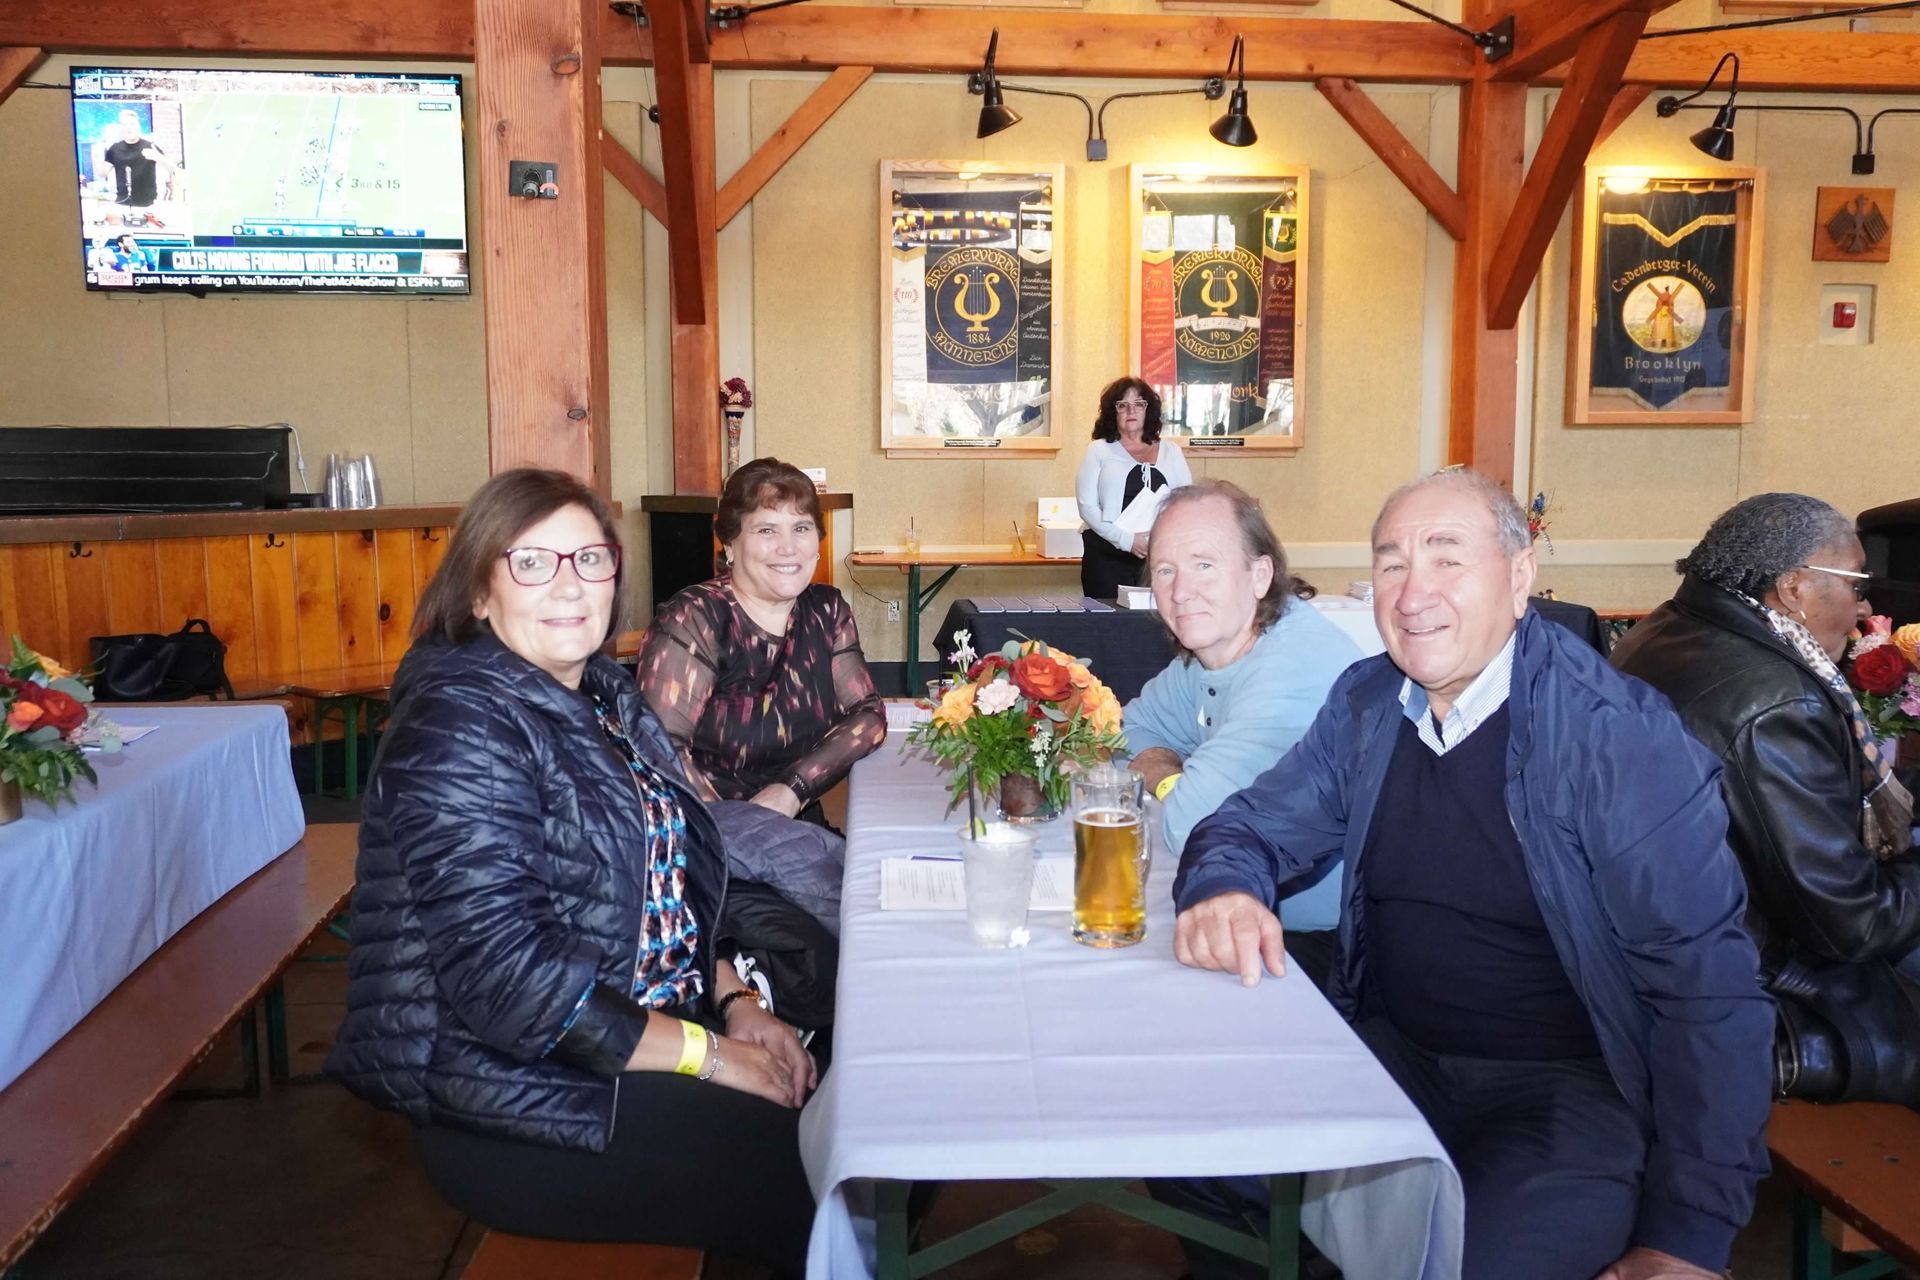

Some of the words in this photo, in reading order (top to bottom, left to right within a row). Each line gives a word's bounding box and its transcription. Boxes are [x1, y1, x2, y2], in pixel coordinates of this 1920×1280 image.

[387, 179, 400, 189] 15
[172, 251, 207, 270] COLTS
[208, 252, 250, 271] MOVING
[251, 252, 304, 272] FORWARD
[304, 253, 334, 272] WITH
[334, 253, 356, 272] JOE
[356, 253, 399, 273] FLACCO
[162, 273, 190, 287] keeps
[192, 274, 222, 287] rolling
[224, 277, 236, 286] on
[397, 277, 407, 287] &
[408, 277, 440, 288] ESPN+
[442, 277, 465, 288] from
[967, 332, 991, 344] 1884
[1624, 356, 1701, 373] Brooklyn
